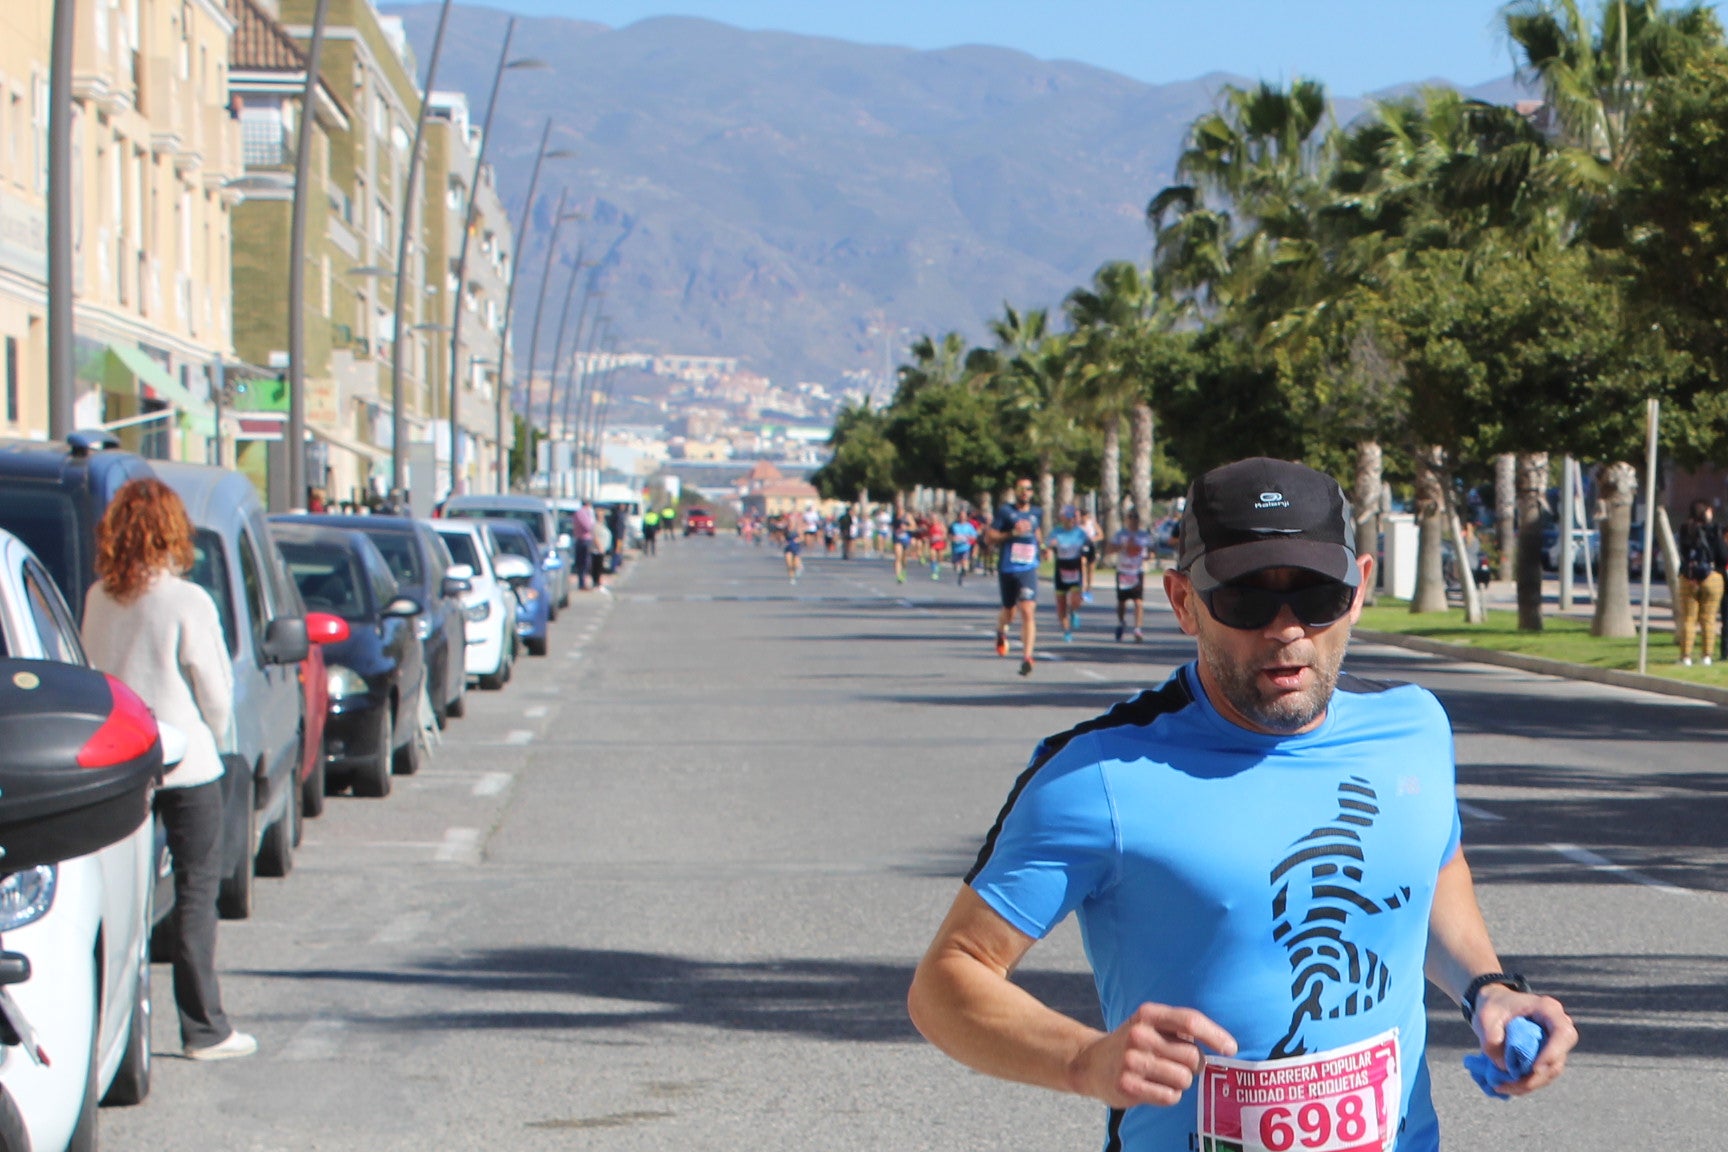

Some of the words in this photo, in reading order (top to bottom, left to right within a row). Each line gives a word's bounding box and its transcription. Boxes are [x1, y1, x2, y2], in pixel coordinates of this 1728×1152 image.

[1236, 1071, 1255, 1087] VIII
[1260, 1065, 1318, 1087] CARRERA
[1322, 1051, 1372, 1077] POPULAR
[1236, 1087, 1285, 1103] CIUDAD
[1288, 1085, 1305, 1100] DE
[1309, 1070, 1369, 1098] ROQUETAS
[1259, 1095, 1367, 1152] 698
